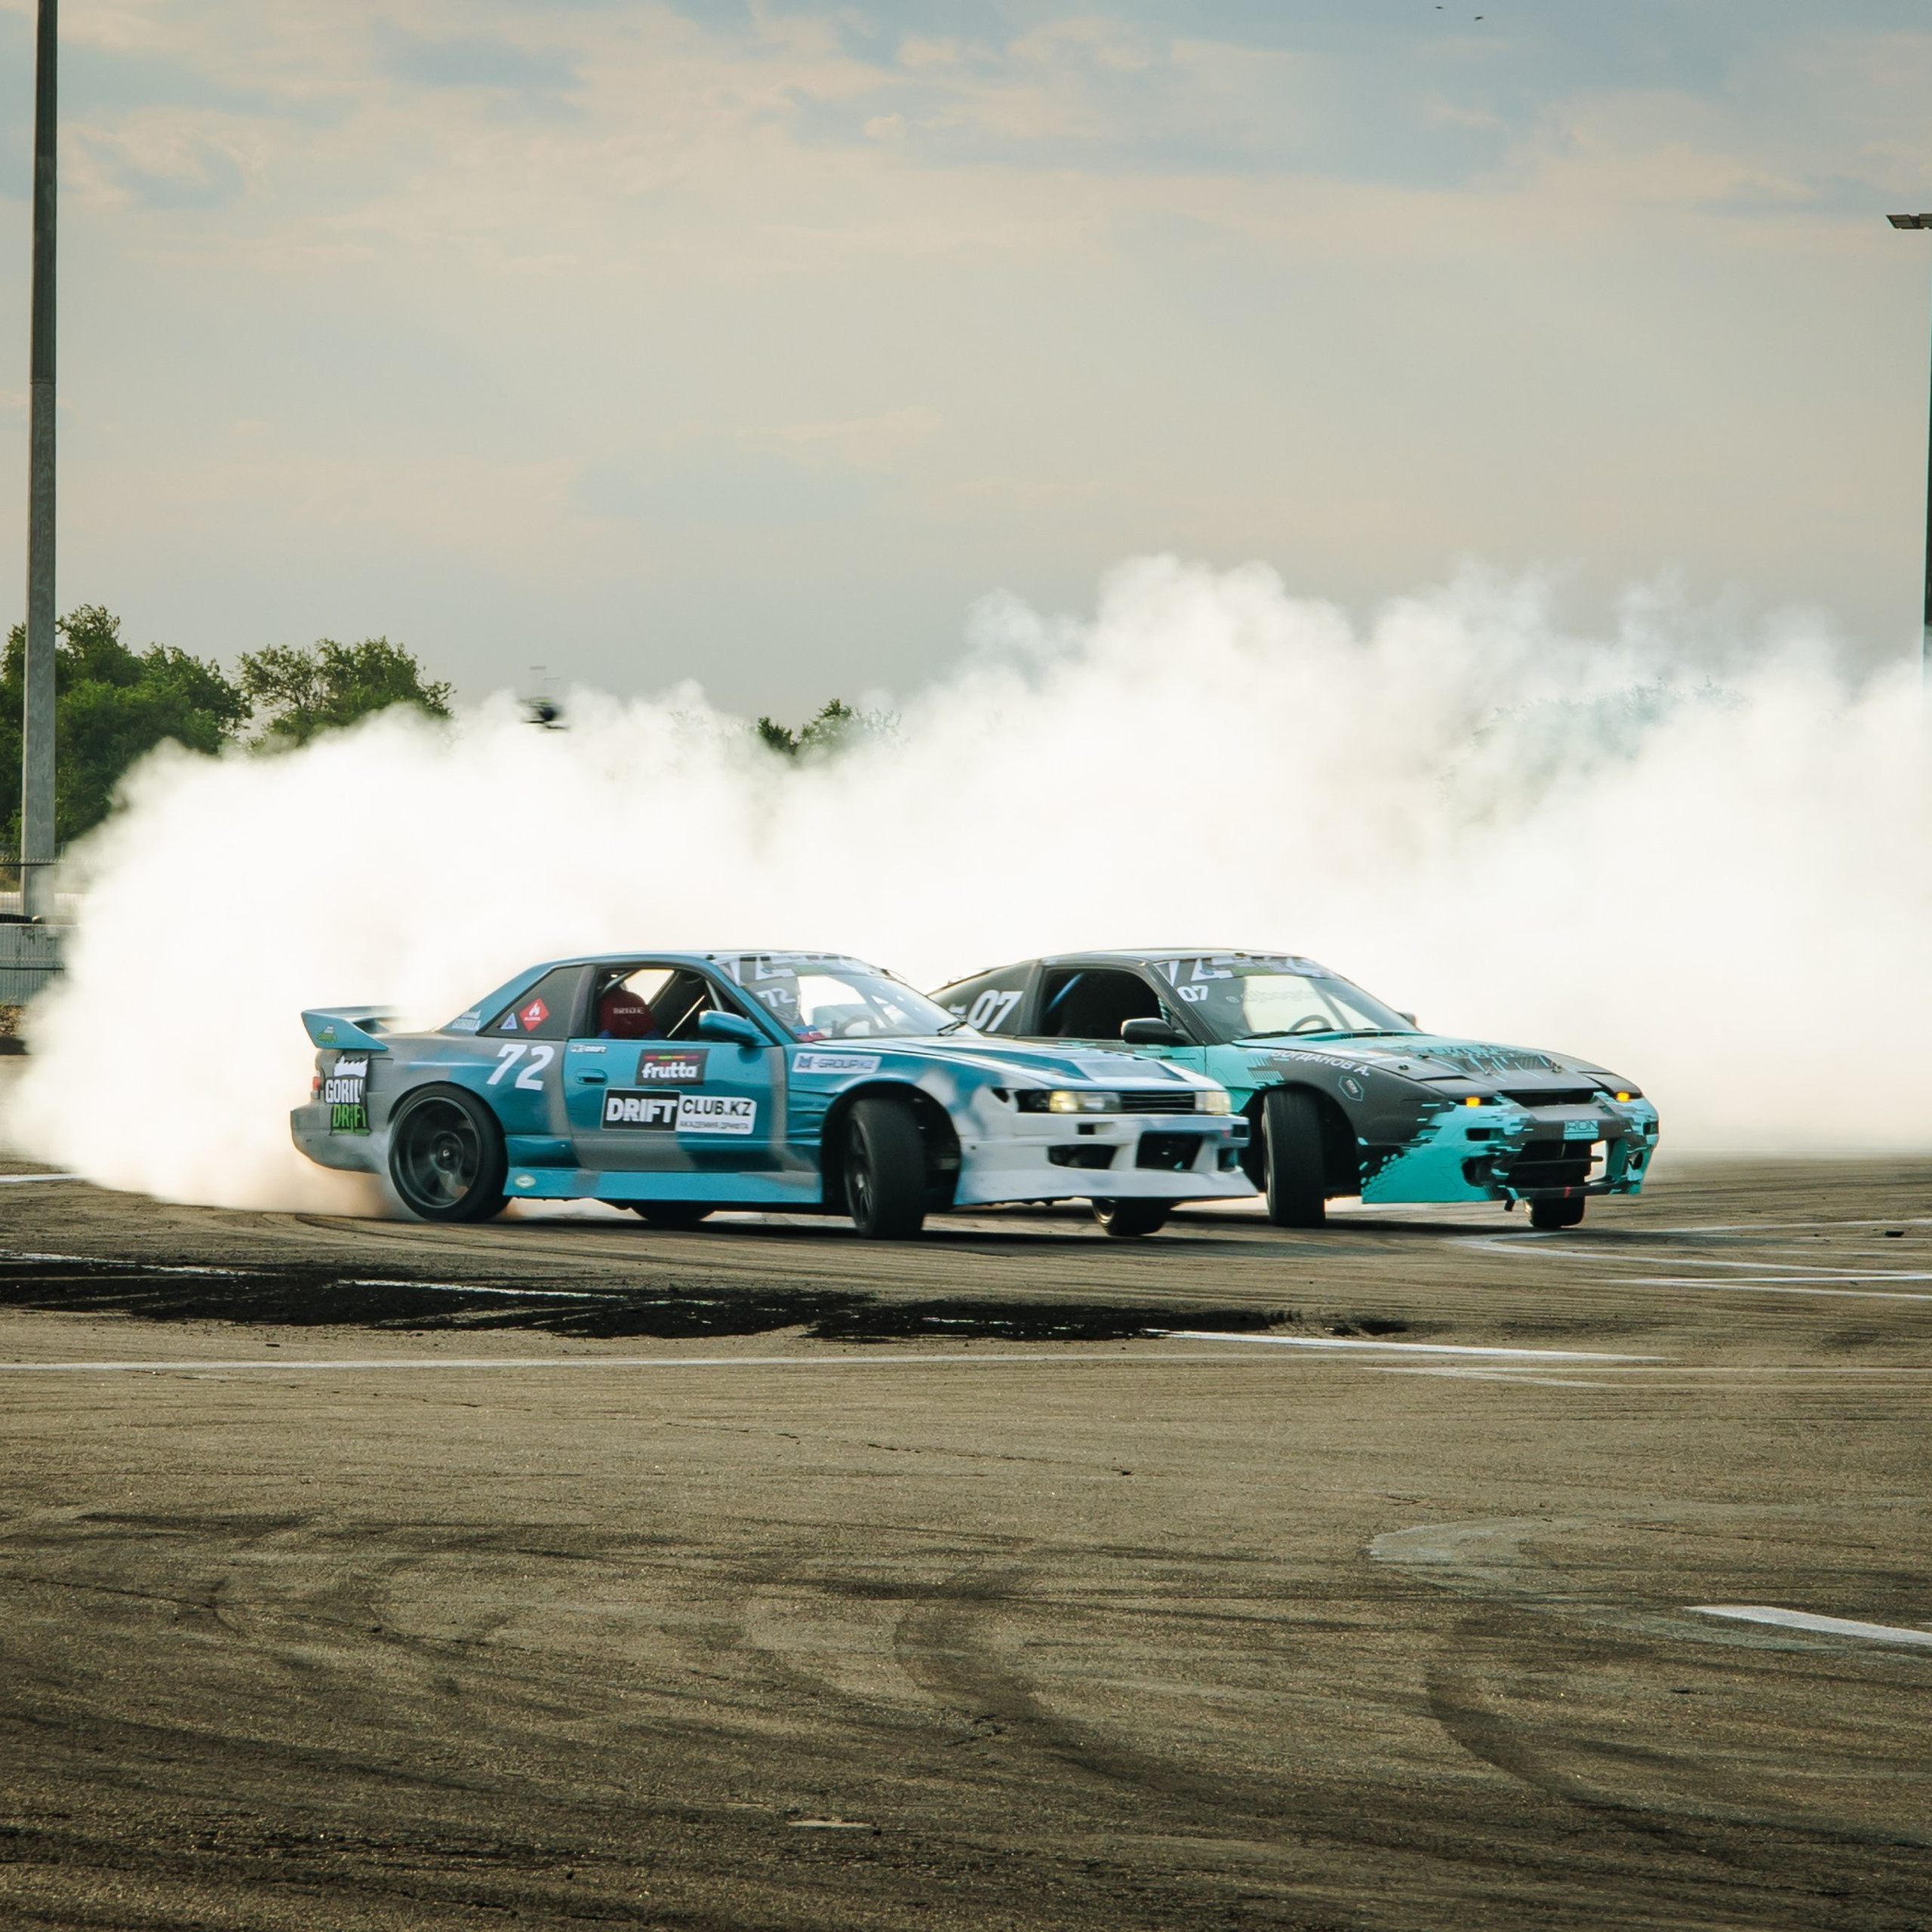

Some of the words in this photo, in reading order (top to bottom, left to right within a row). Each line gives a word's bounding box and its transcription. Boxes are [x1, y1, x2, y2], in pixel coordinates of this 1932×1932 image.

[757, 988, 796, 1008] 72
[1177, 985, 1208, 1002] 07
[967, 989, 1024, 1032] 07
[486, 1044, 555, 1091] 72
[641, 1062, 697, 1078] frutta
[605, 1098, 678, 1123] DRIFT
[682, 1100, 752, 1116] CLUB.KZ
